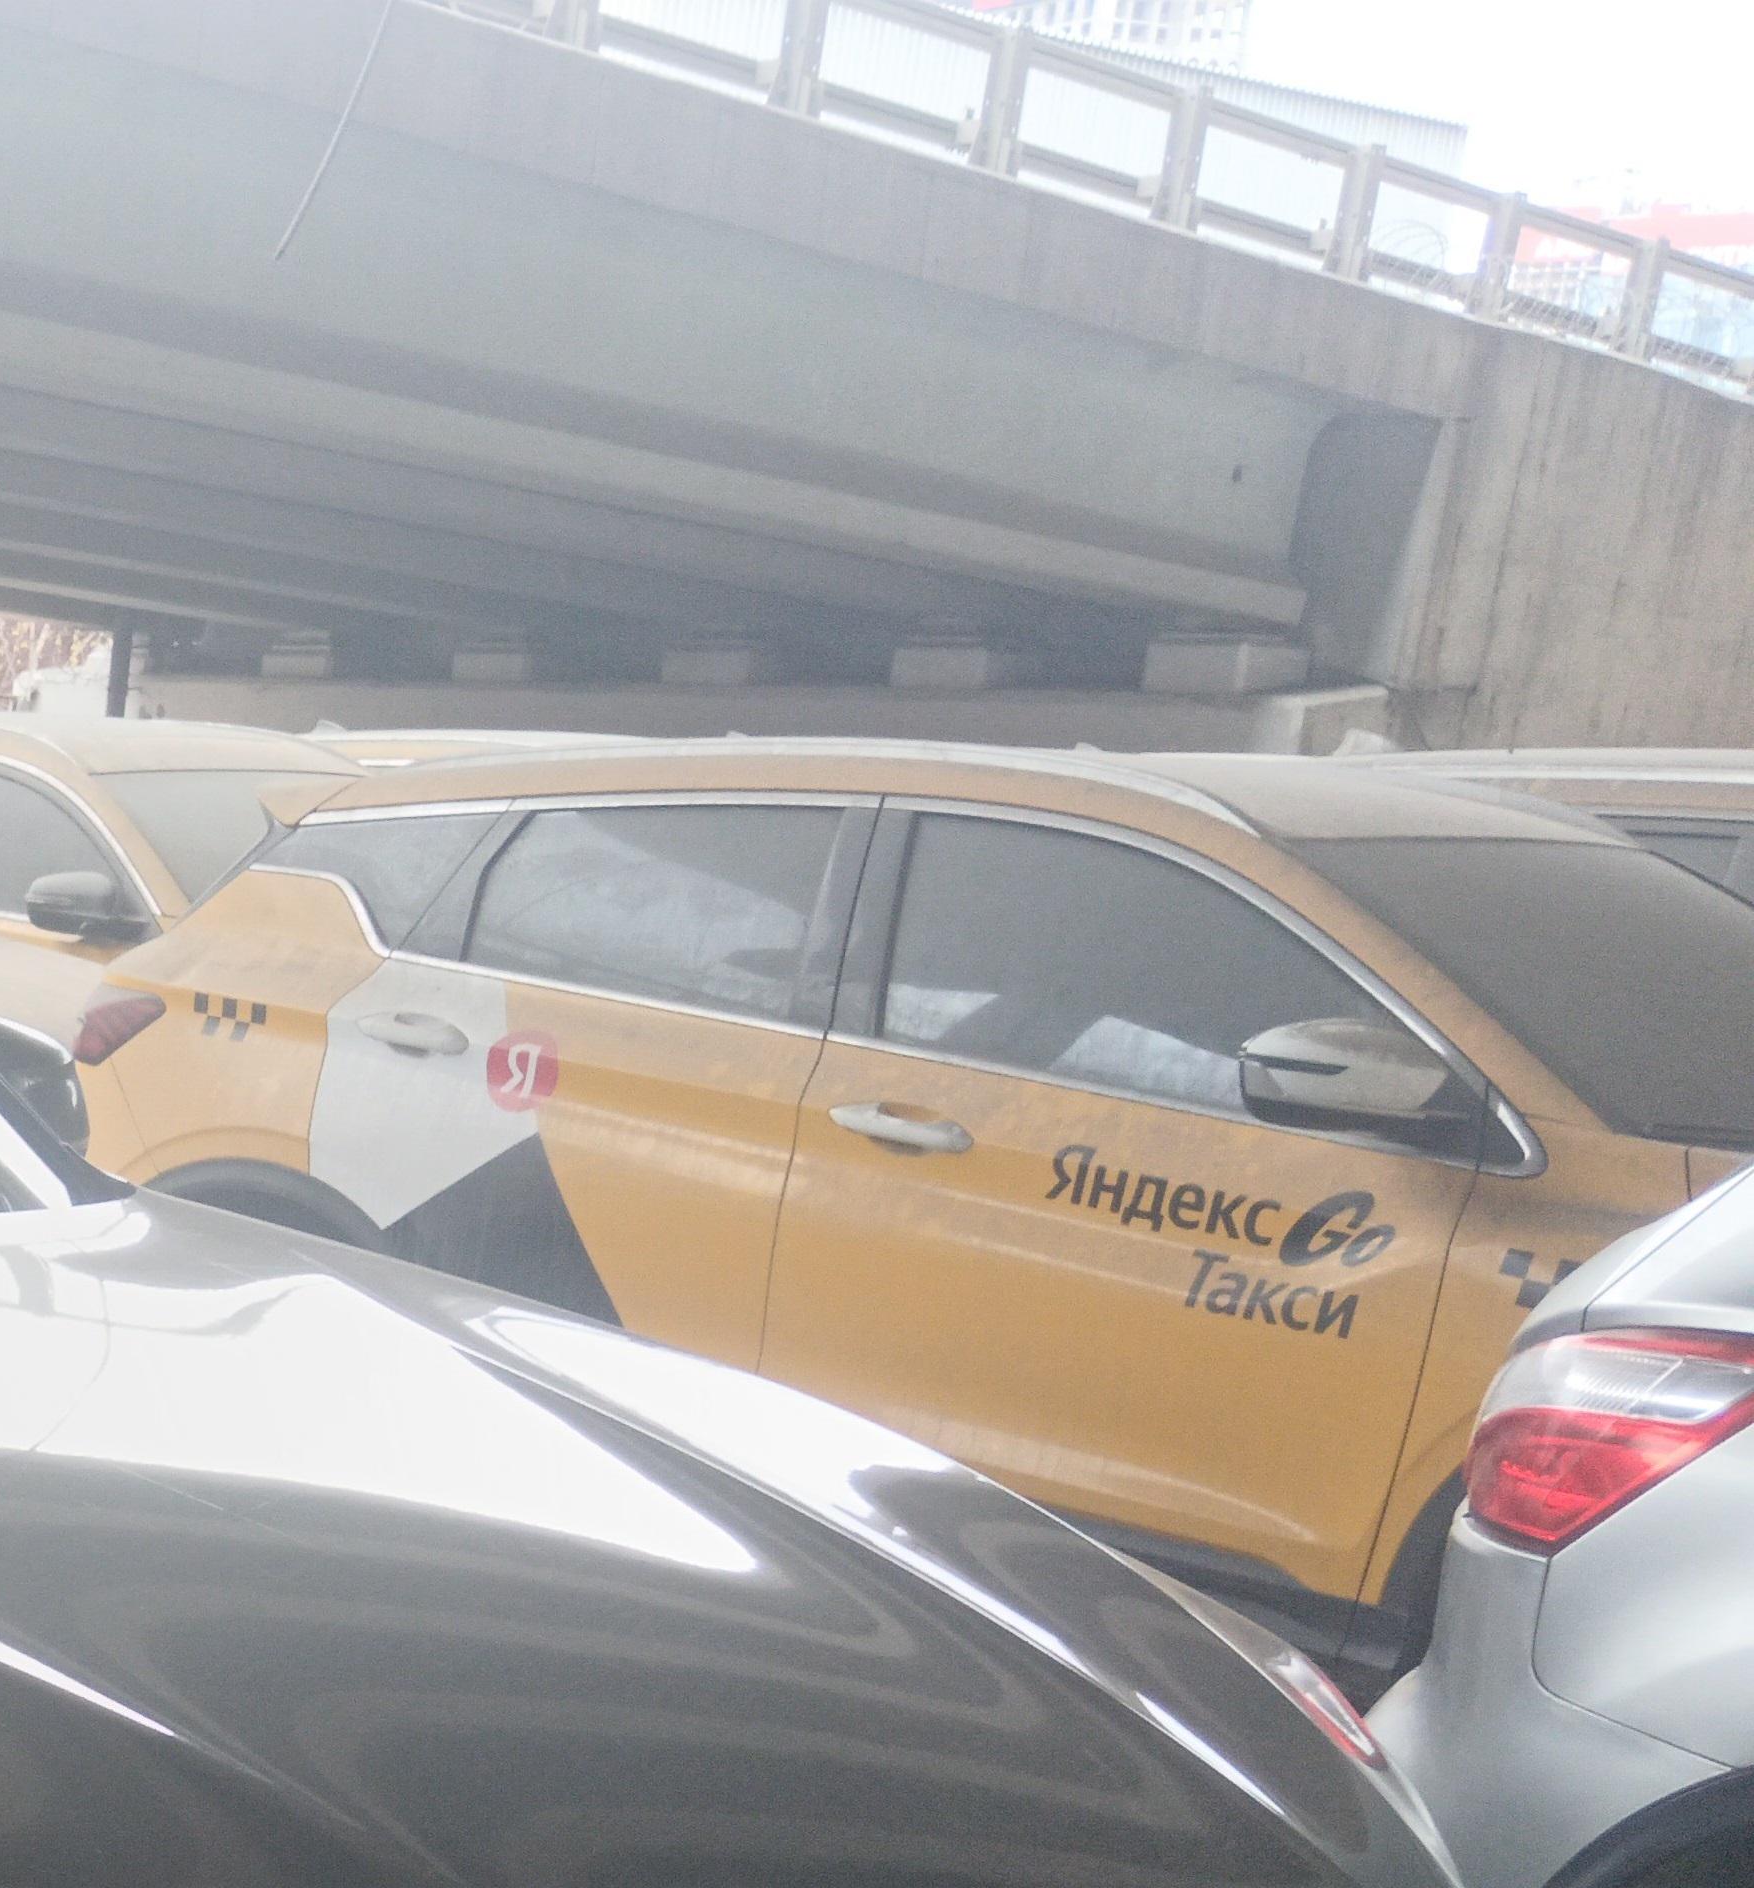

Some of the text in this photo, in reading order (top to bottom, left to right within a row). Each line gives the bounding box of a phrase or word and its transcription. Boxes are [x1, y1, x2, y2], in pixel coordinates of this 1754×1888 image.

[499, 1043, 542, 1100] Я
[1045, 1143, 1397, 1268] Яндекс Go
[1183, 1247, 1360, 1340] Такси
